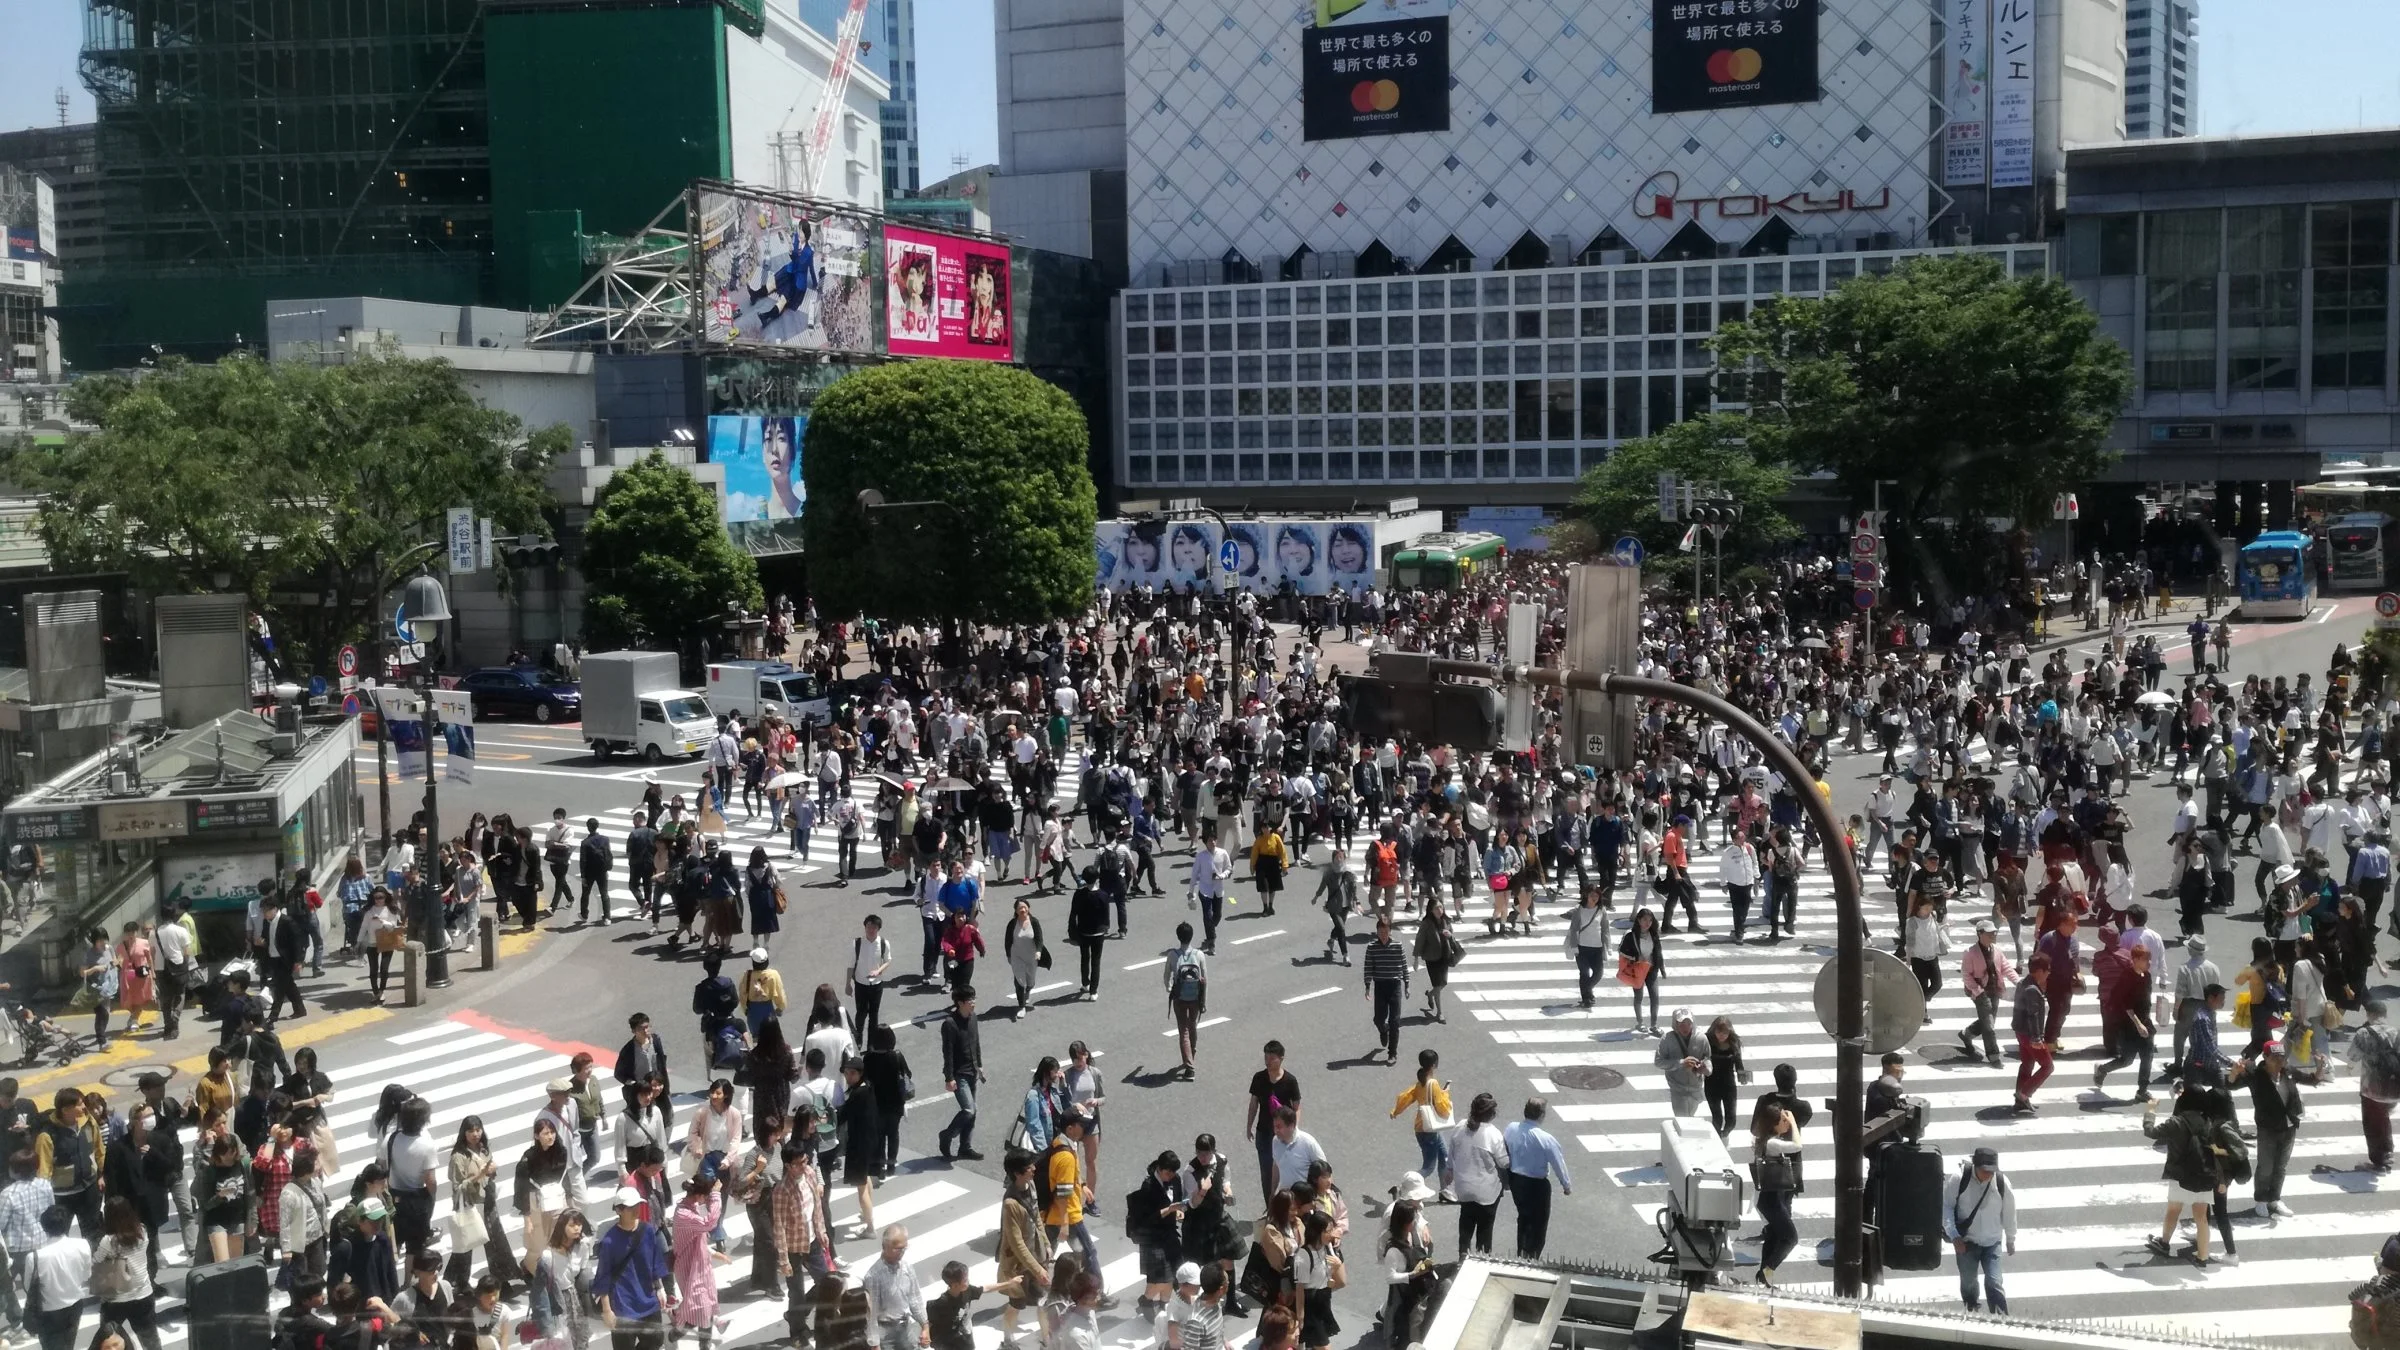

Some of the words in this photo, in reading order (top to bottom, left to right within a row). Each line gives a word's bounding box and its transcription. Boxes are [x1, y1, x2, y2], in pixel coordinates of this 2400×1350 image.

[1672, 0, 1799, 20] 世界で最も多くの
[1686, 20, 1783, 41] 場所で使える
[1320, 30, 1432, 53] 世界で最も多くの
[1333, 53, 1418, 73] 場所で使える
[1708, 82, 1760, 93] mastercard
[1353, 112, 1399, 122] mastercard
[1676, 187, 1889, 220] TOKYU
[719, 305, 732, 316] 50
[458, 513, 472, 569] 渋谷駅前
[17, 824, 59, 839] 渋谷駅
[216, 886, 262, 899] しぶち
